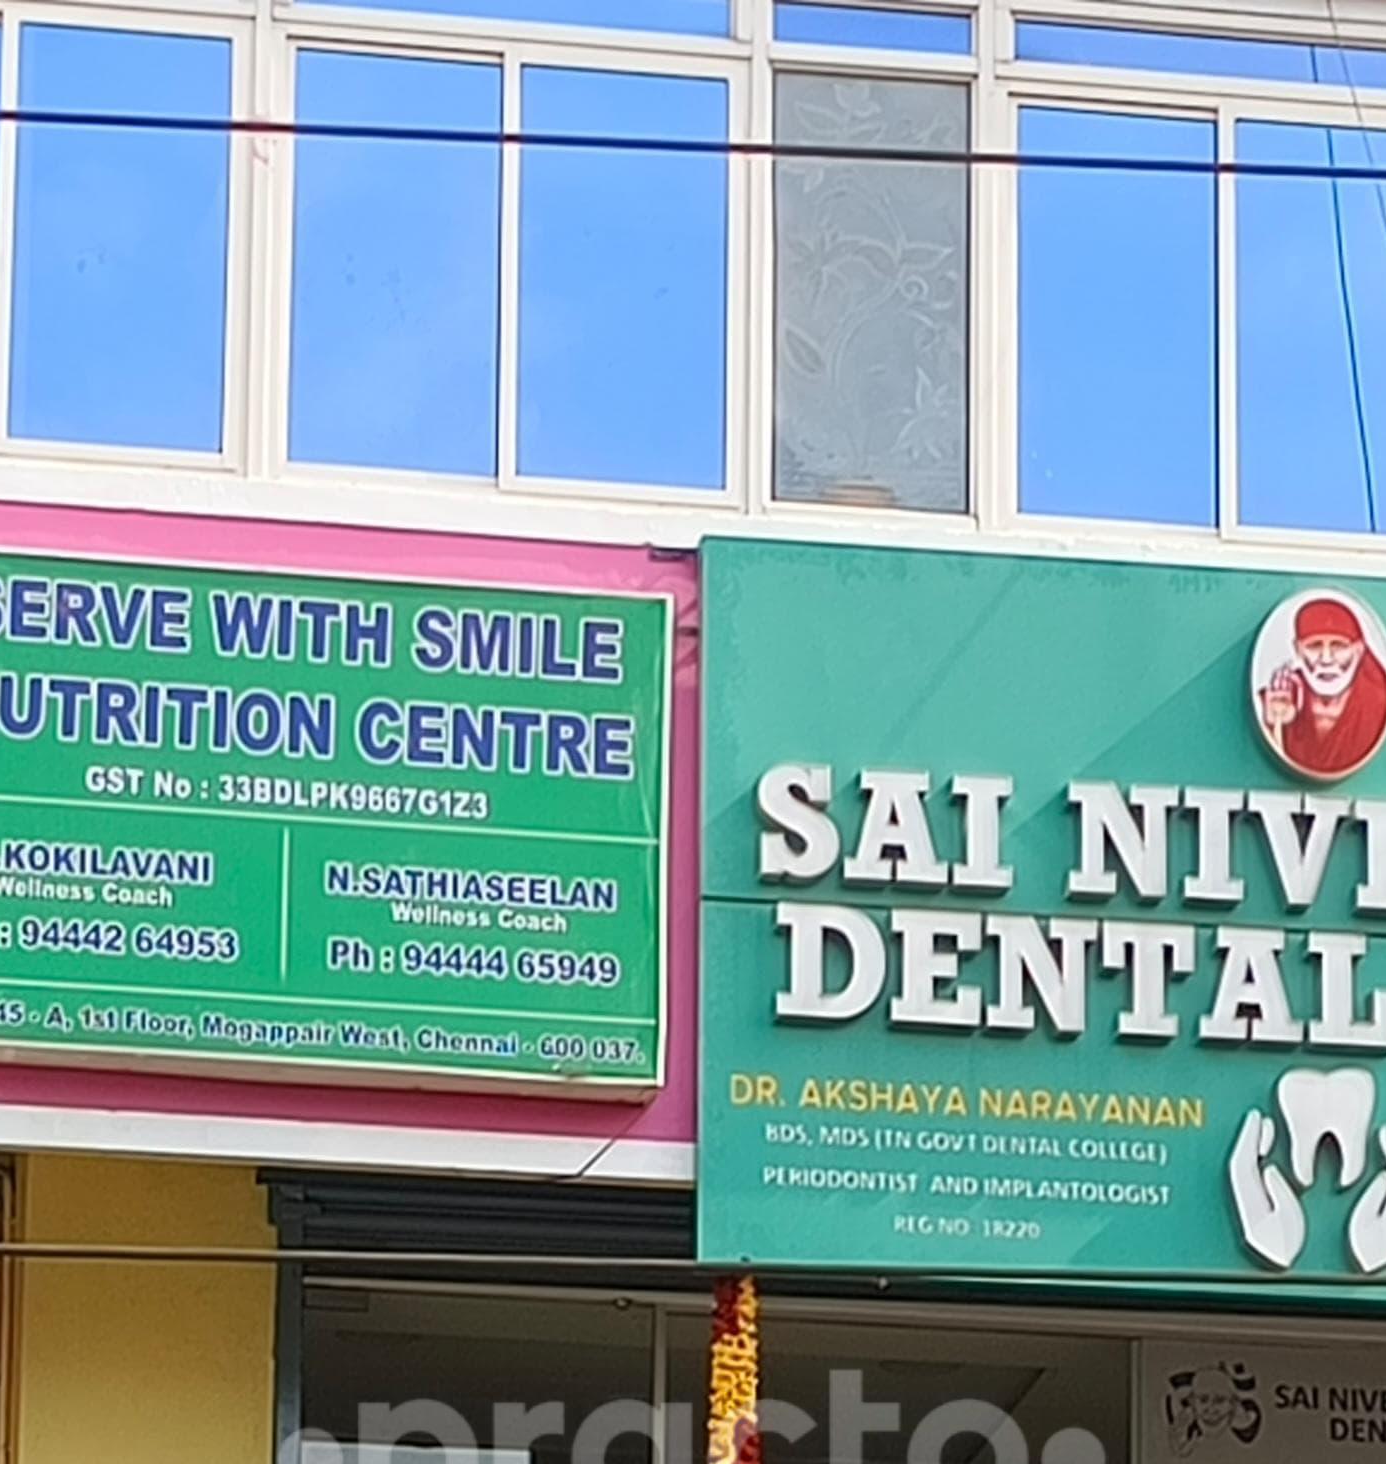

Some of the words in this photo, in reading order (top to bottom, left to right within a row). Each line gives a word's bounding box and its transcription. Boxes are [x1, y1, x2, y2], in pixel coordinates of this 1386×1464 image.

[213, 594, 391, 666] WITH
[412, 610, 624, 682] SMILE
[356, 700, 636, 779] CENTRE
[85, 765, 144, 796] GST
[154, 771, 190, 799] No
[756, 763, 1015, 892] SAI
[101, 882, 173, 907] Coach
[325, 862, 617, 911] N.SATHIASEELAN
[21, 917, 125, 954] 94442
[134, 926, 239, 961] 64953
[391, 902, 491, 928] Wellness
[498, 908, 567, 934] Coach
[329, 937, 371, 970] Ph
[403, 942, 507, 978] 94444
[517, 951, 619, 986] 65949
[730, 1073, 786, 1107] DR.
[798, 1079, 967, 1117] AKSHAYA
[979, 1089, 1205, 1128] NARAYANAN
[819, 1126, 870, 1147] MDS
[983, 1136, 1062, 1158] DENTAL
[762, 1166, 918, 1193] PERIODONTIST
[930, 1175, 978, 1197] AND
[984, 1177, 1171, 1206] IMPLANTOLOGIST
[1274, 1384, 1319, 1410] SAI
